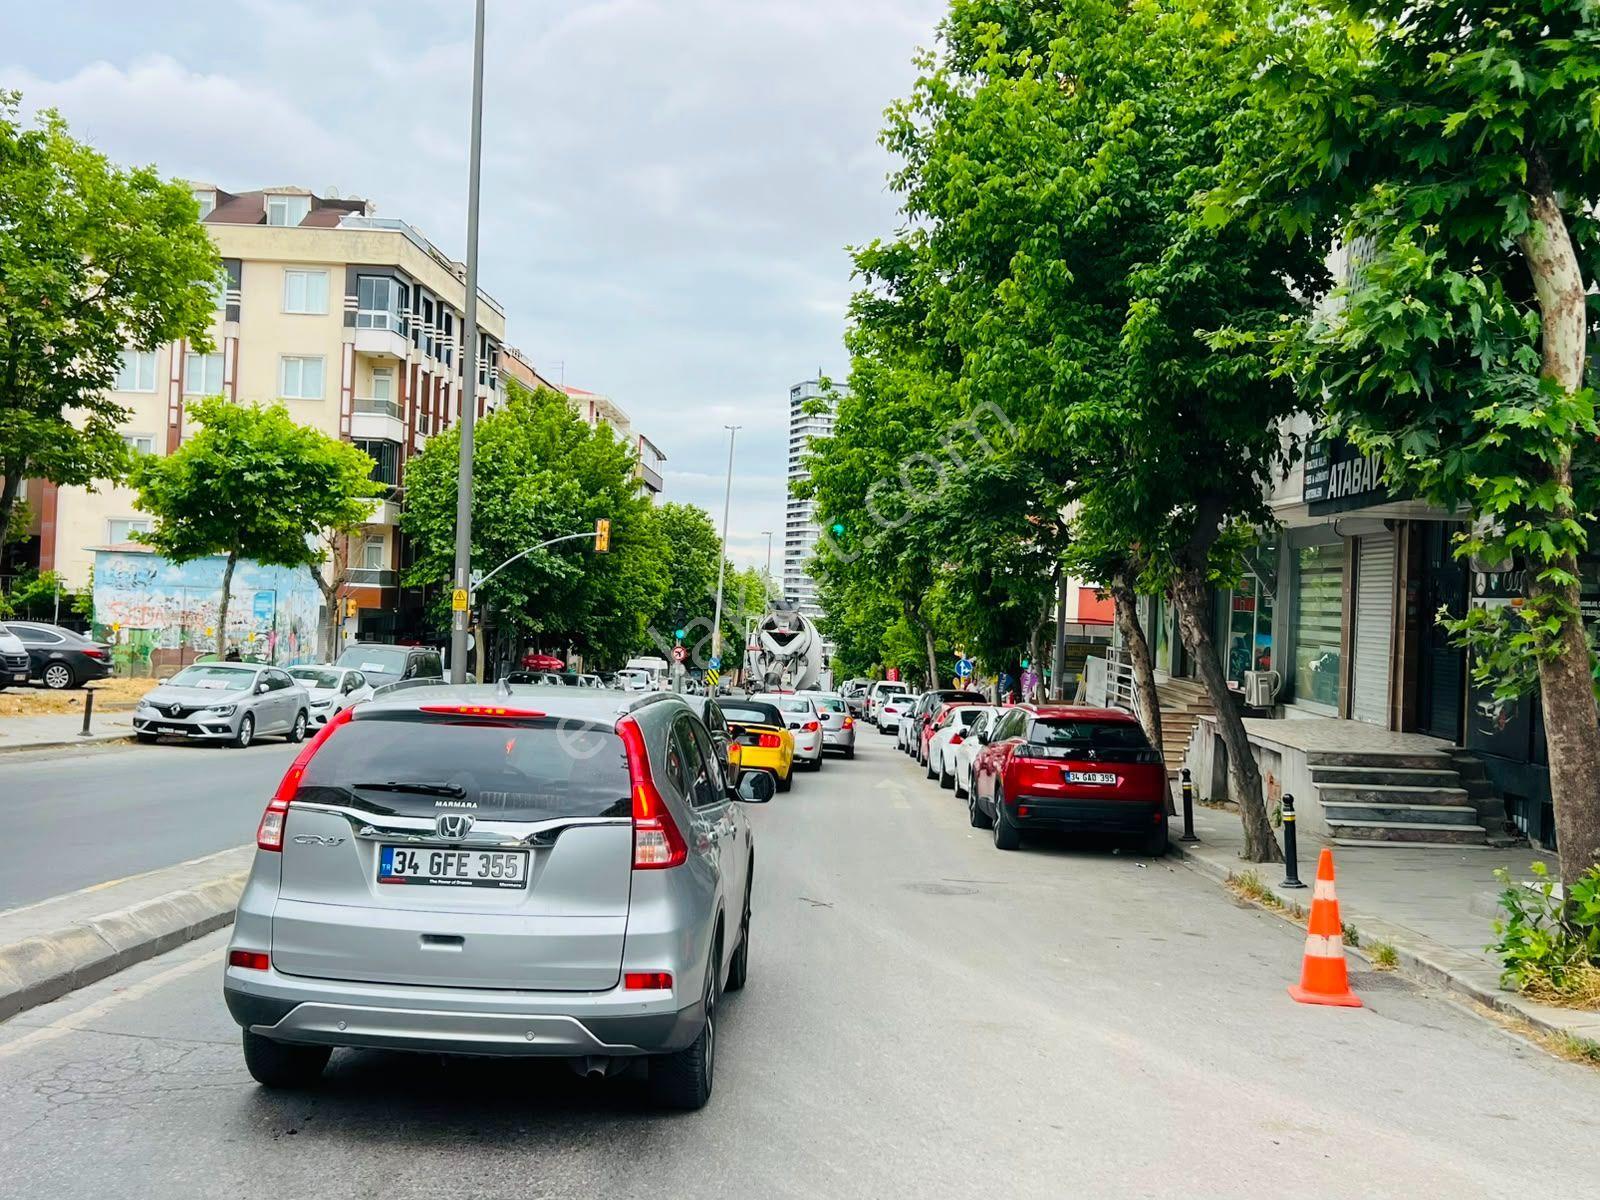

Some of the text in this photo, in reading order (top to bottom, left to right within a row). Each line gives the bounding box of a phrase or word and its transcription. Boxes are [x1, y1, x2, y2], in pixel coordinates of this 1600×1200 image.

[1327, 451, 1382, 500] ATABAY
[434, 800, 478, 809] MARMARA
[381, 850, 518, 879] TR 34 GFE 355
